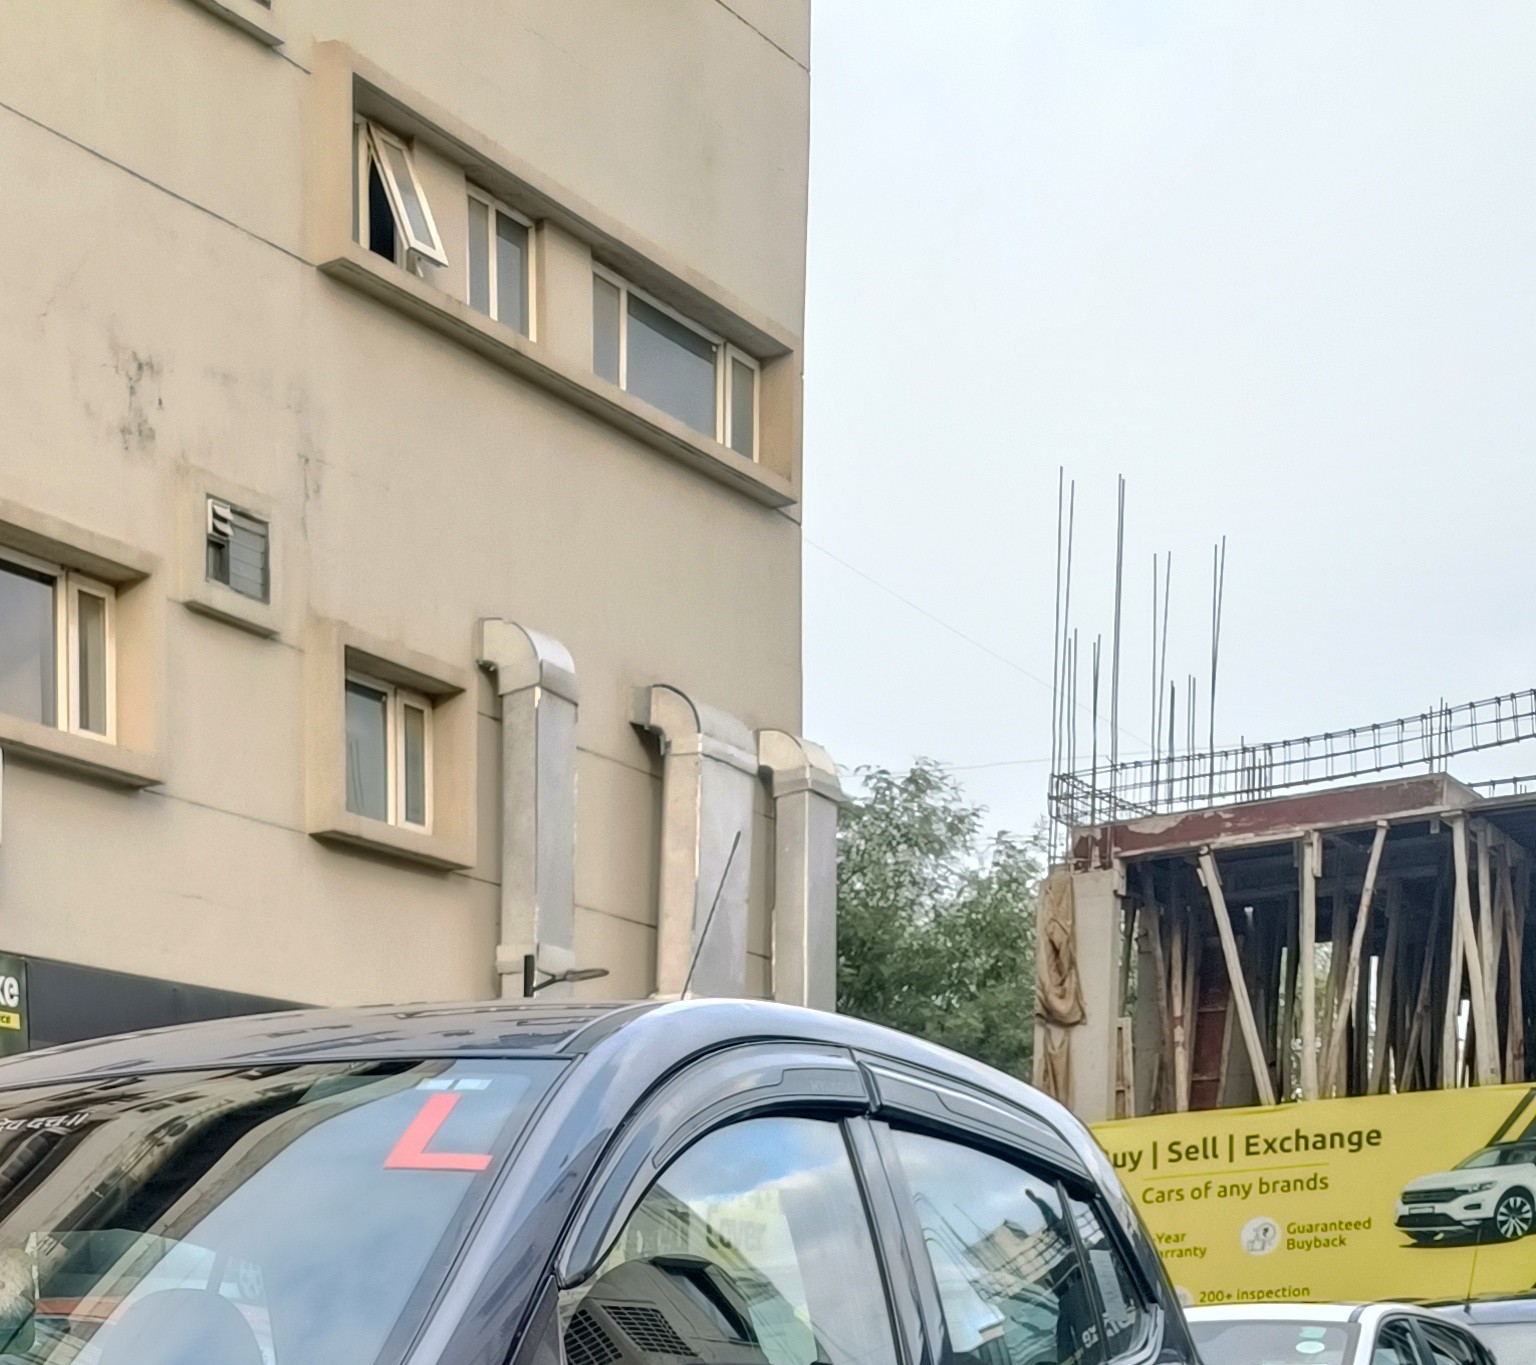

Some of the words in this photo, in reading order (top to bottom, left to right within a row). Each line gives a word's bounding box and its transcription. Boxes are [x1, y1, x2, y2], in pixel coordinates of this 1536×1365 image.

[383, 1093, 493, 1171] L
[1167, 1136, 1219, 1163] Sell
[1245, 1128, 1383, 1154] Exchange
[1141, 1187, 1185, 1204] Cars
[1190, 1181, 1213, 1200] of
[1217, 1182, 1253, 1201] any
[1258, 1173, 1329, 1195] brands
[1286, 1217, 1373, 1236] Guaranteed
[1159, 1246, 1207, 1259] rranty
[1286, 1234, 1347, 1252] Buyback
[1199, 1290, 1232, 1303] 200+
[1236, 1284, 1311, 1301] inspection
